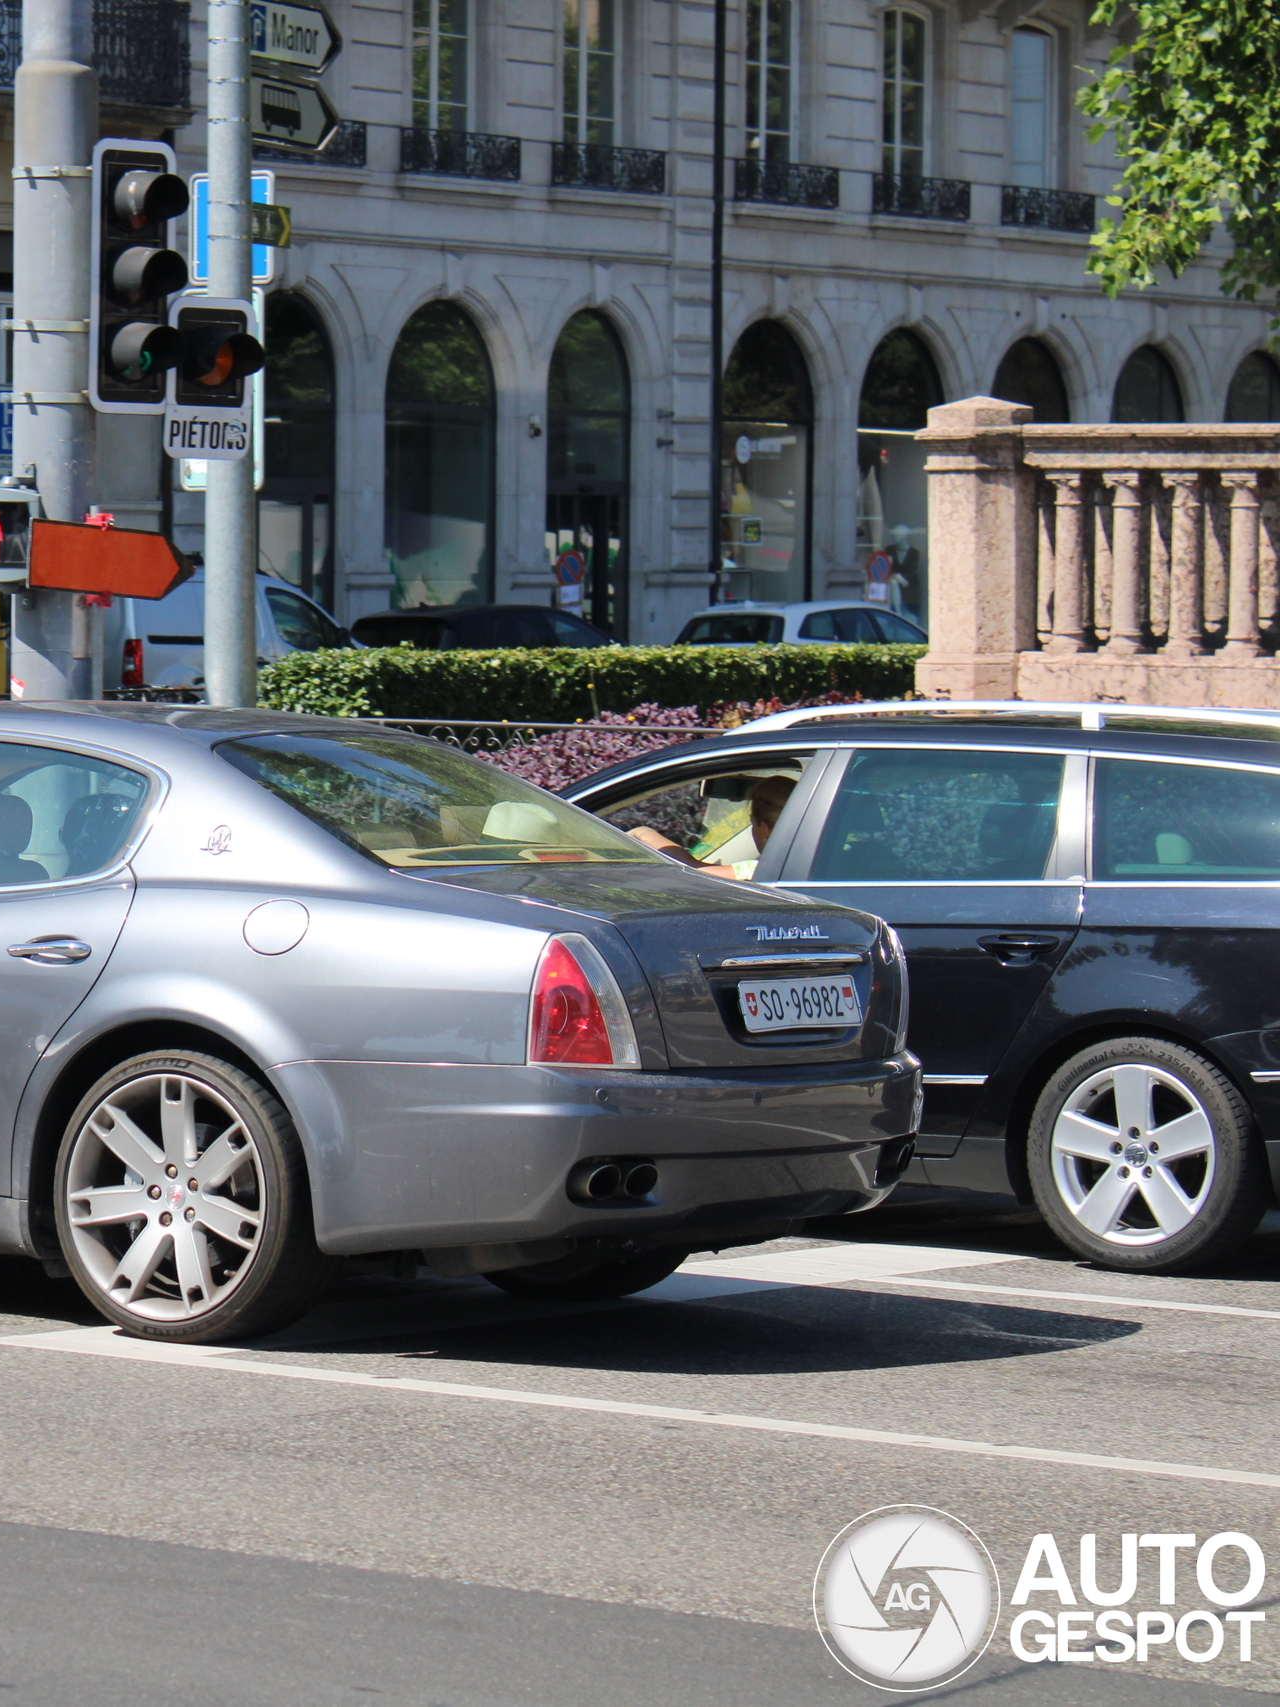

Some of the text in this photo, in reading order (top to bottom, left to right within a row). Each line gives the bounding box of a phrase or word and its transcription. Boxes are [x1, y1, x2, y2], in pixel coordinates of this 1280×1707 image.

[271, 12, 319, 55] Manor
[1058, 1050, 1109, 1092] Continental
[1157, 1051, 1198, 1079] 235/45
